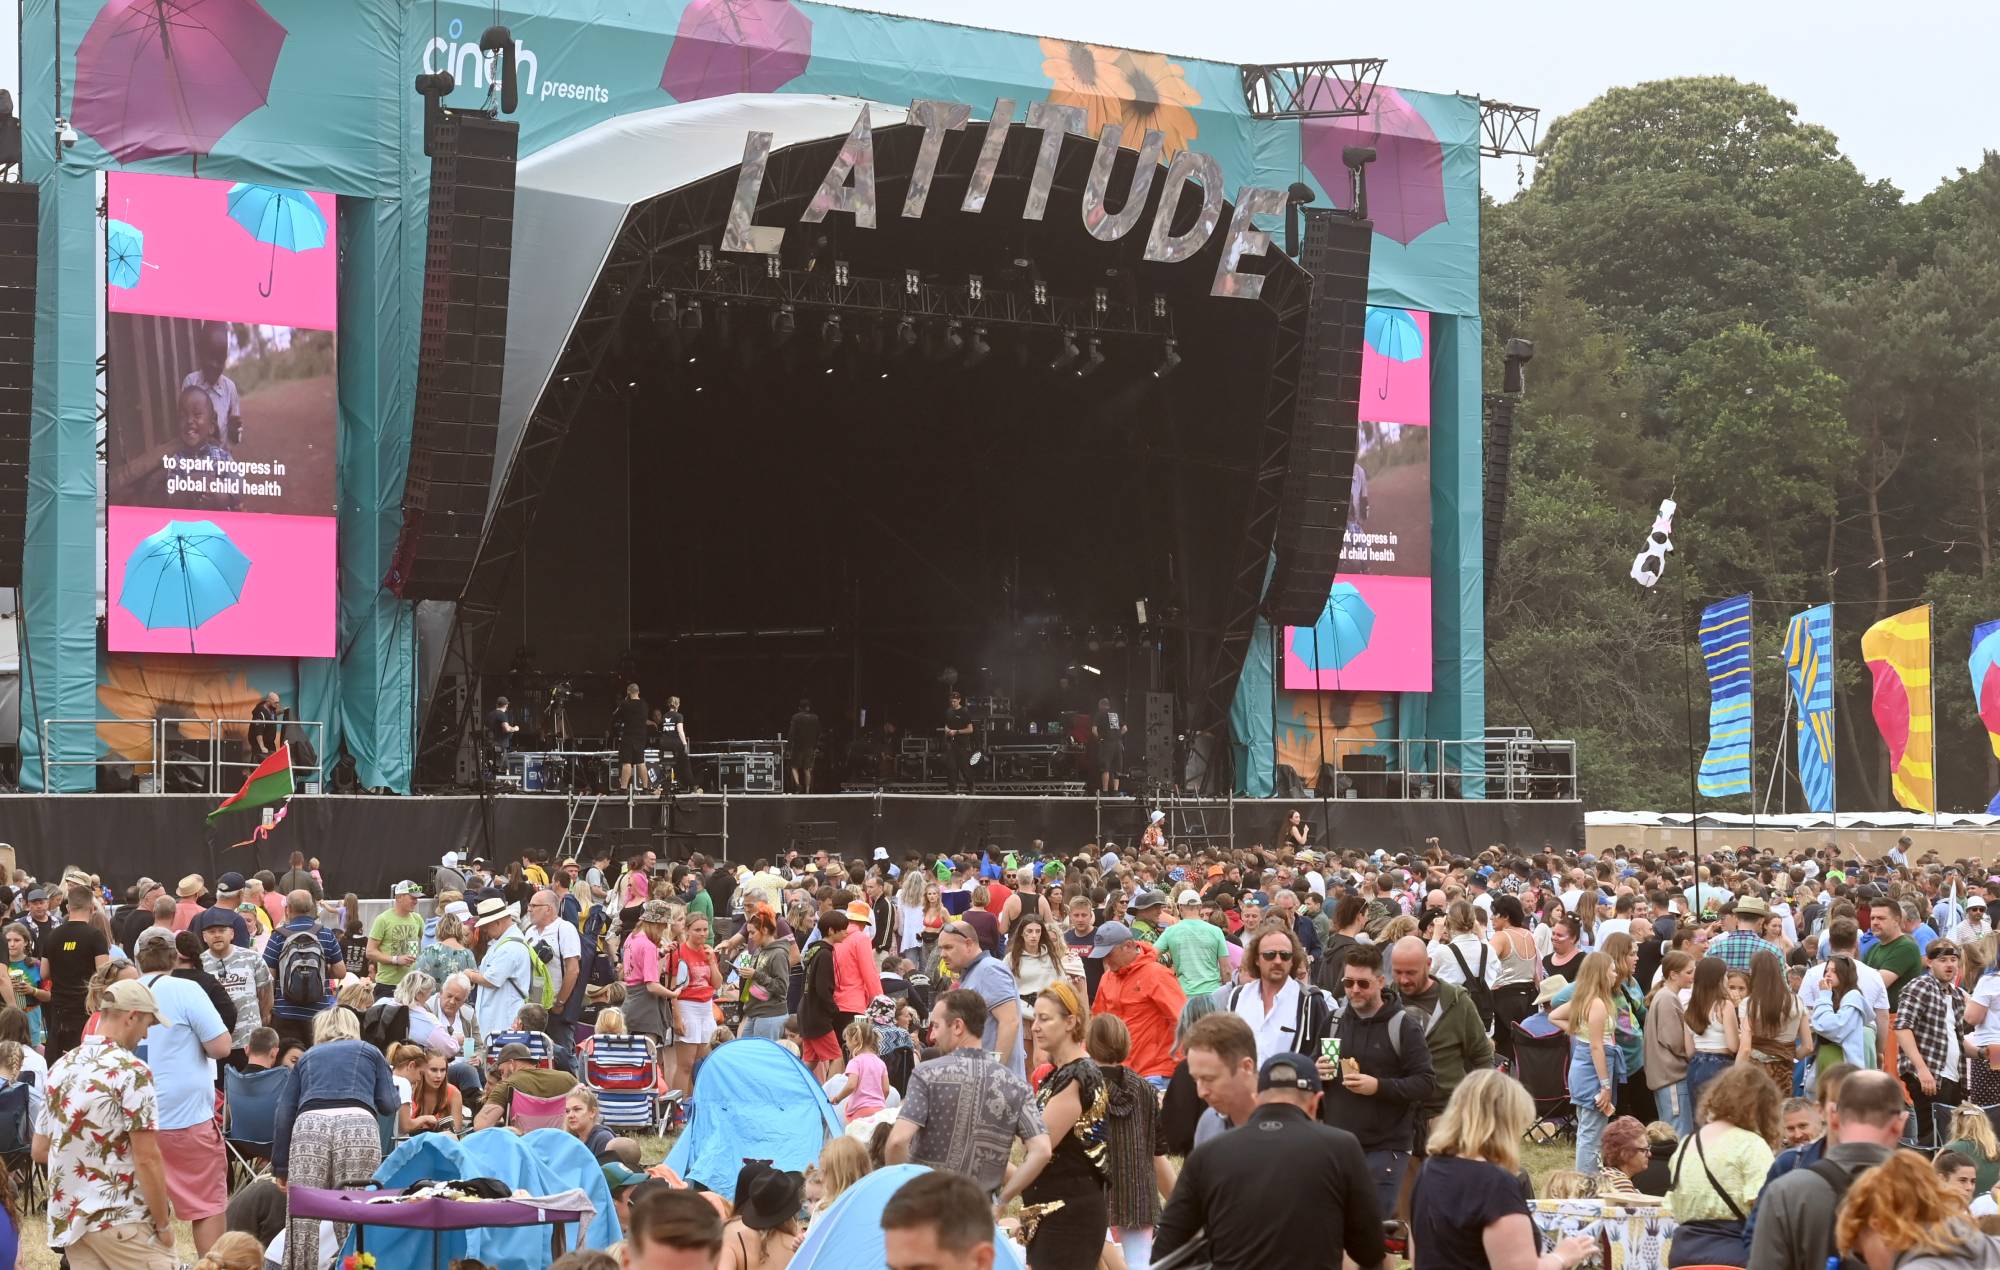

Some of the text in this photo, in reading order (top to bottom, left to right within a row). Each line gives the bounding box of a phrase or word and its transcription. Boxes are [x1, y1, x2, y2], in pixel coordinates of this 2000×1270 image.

[423, 19, 609, 103] cinch presents
[721, 97, 1291, 299] LATITUDE
[163, 454, 285, 476] to spark progress in
[167, 475, 281, 496] global child health
[1353, 532, 1388, 545] progress
[1389, 531, 1397, 544] in
[1348, 547, 1367, 560] child
[1369, 548, 1395, 561] health
